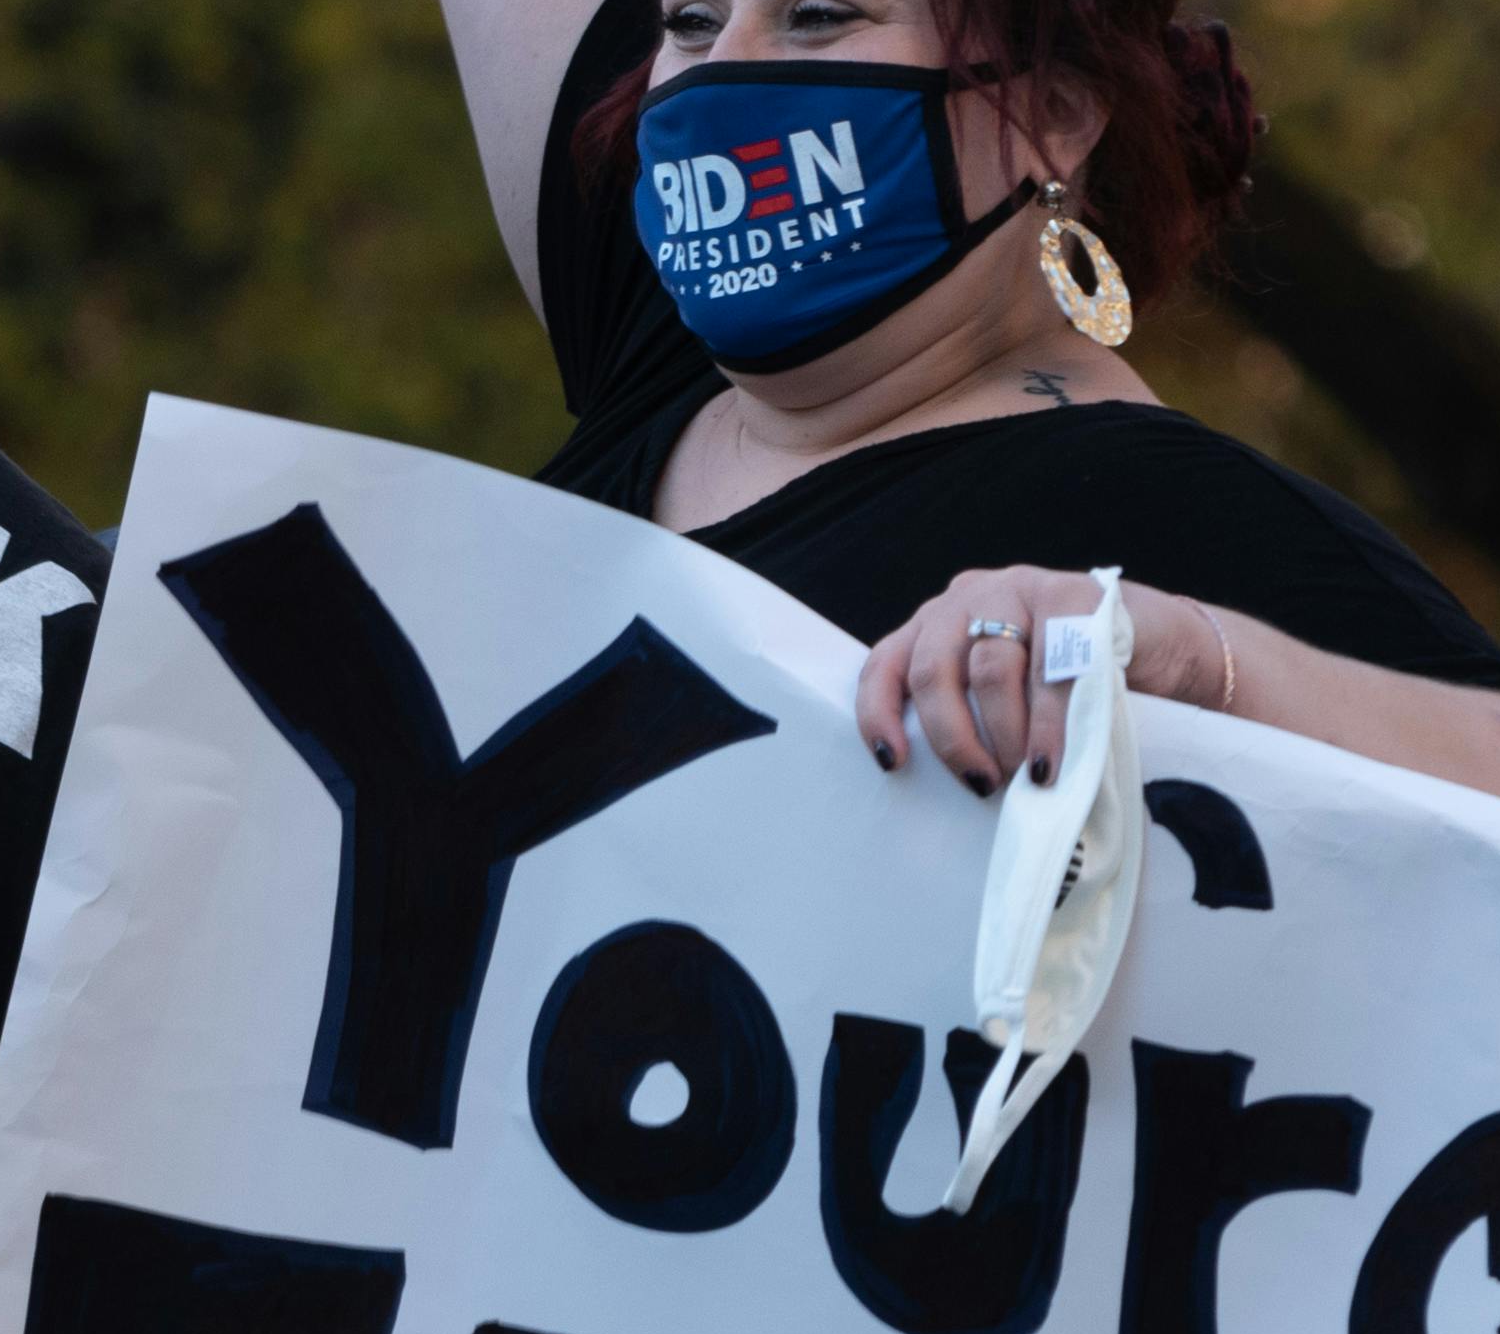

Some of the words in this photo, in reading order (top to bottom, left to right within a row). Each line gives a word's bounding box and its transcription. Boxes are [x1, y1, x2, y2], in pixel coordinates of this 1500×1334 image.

[653, 120, 865, 235] BIDEN
[656, 198, 866, 271] PRESIDENT
[708, 262, 778, 299] 2020
